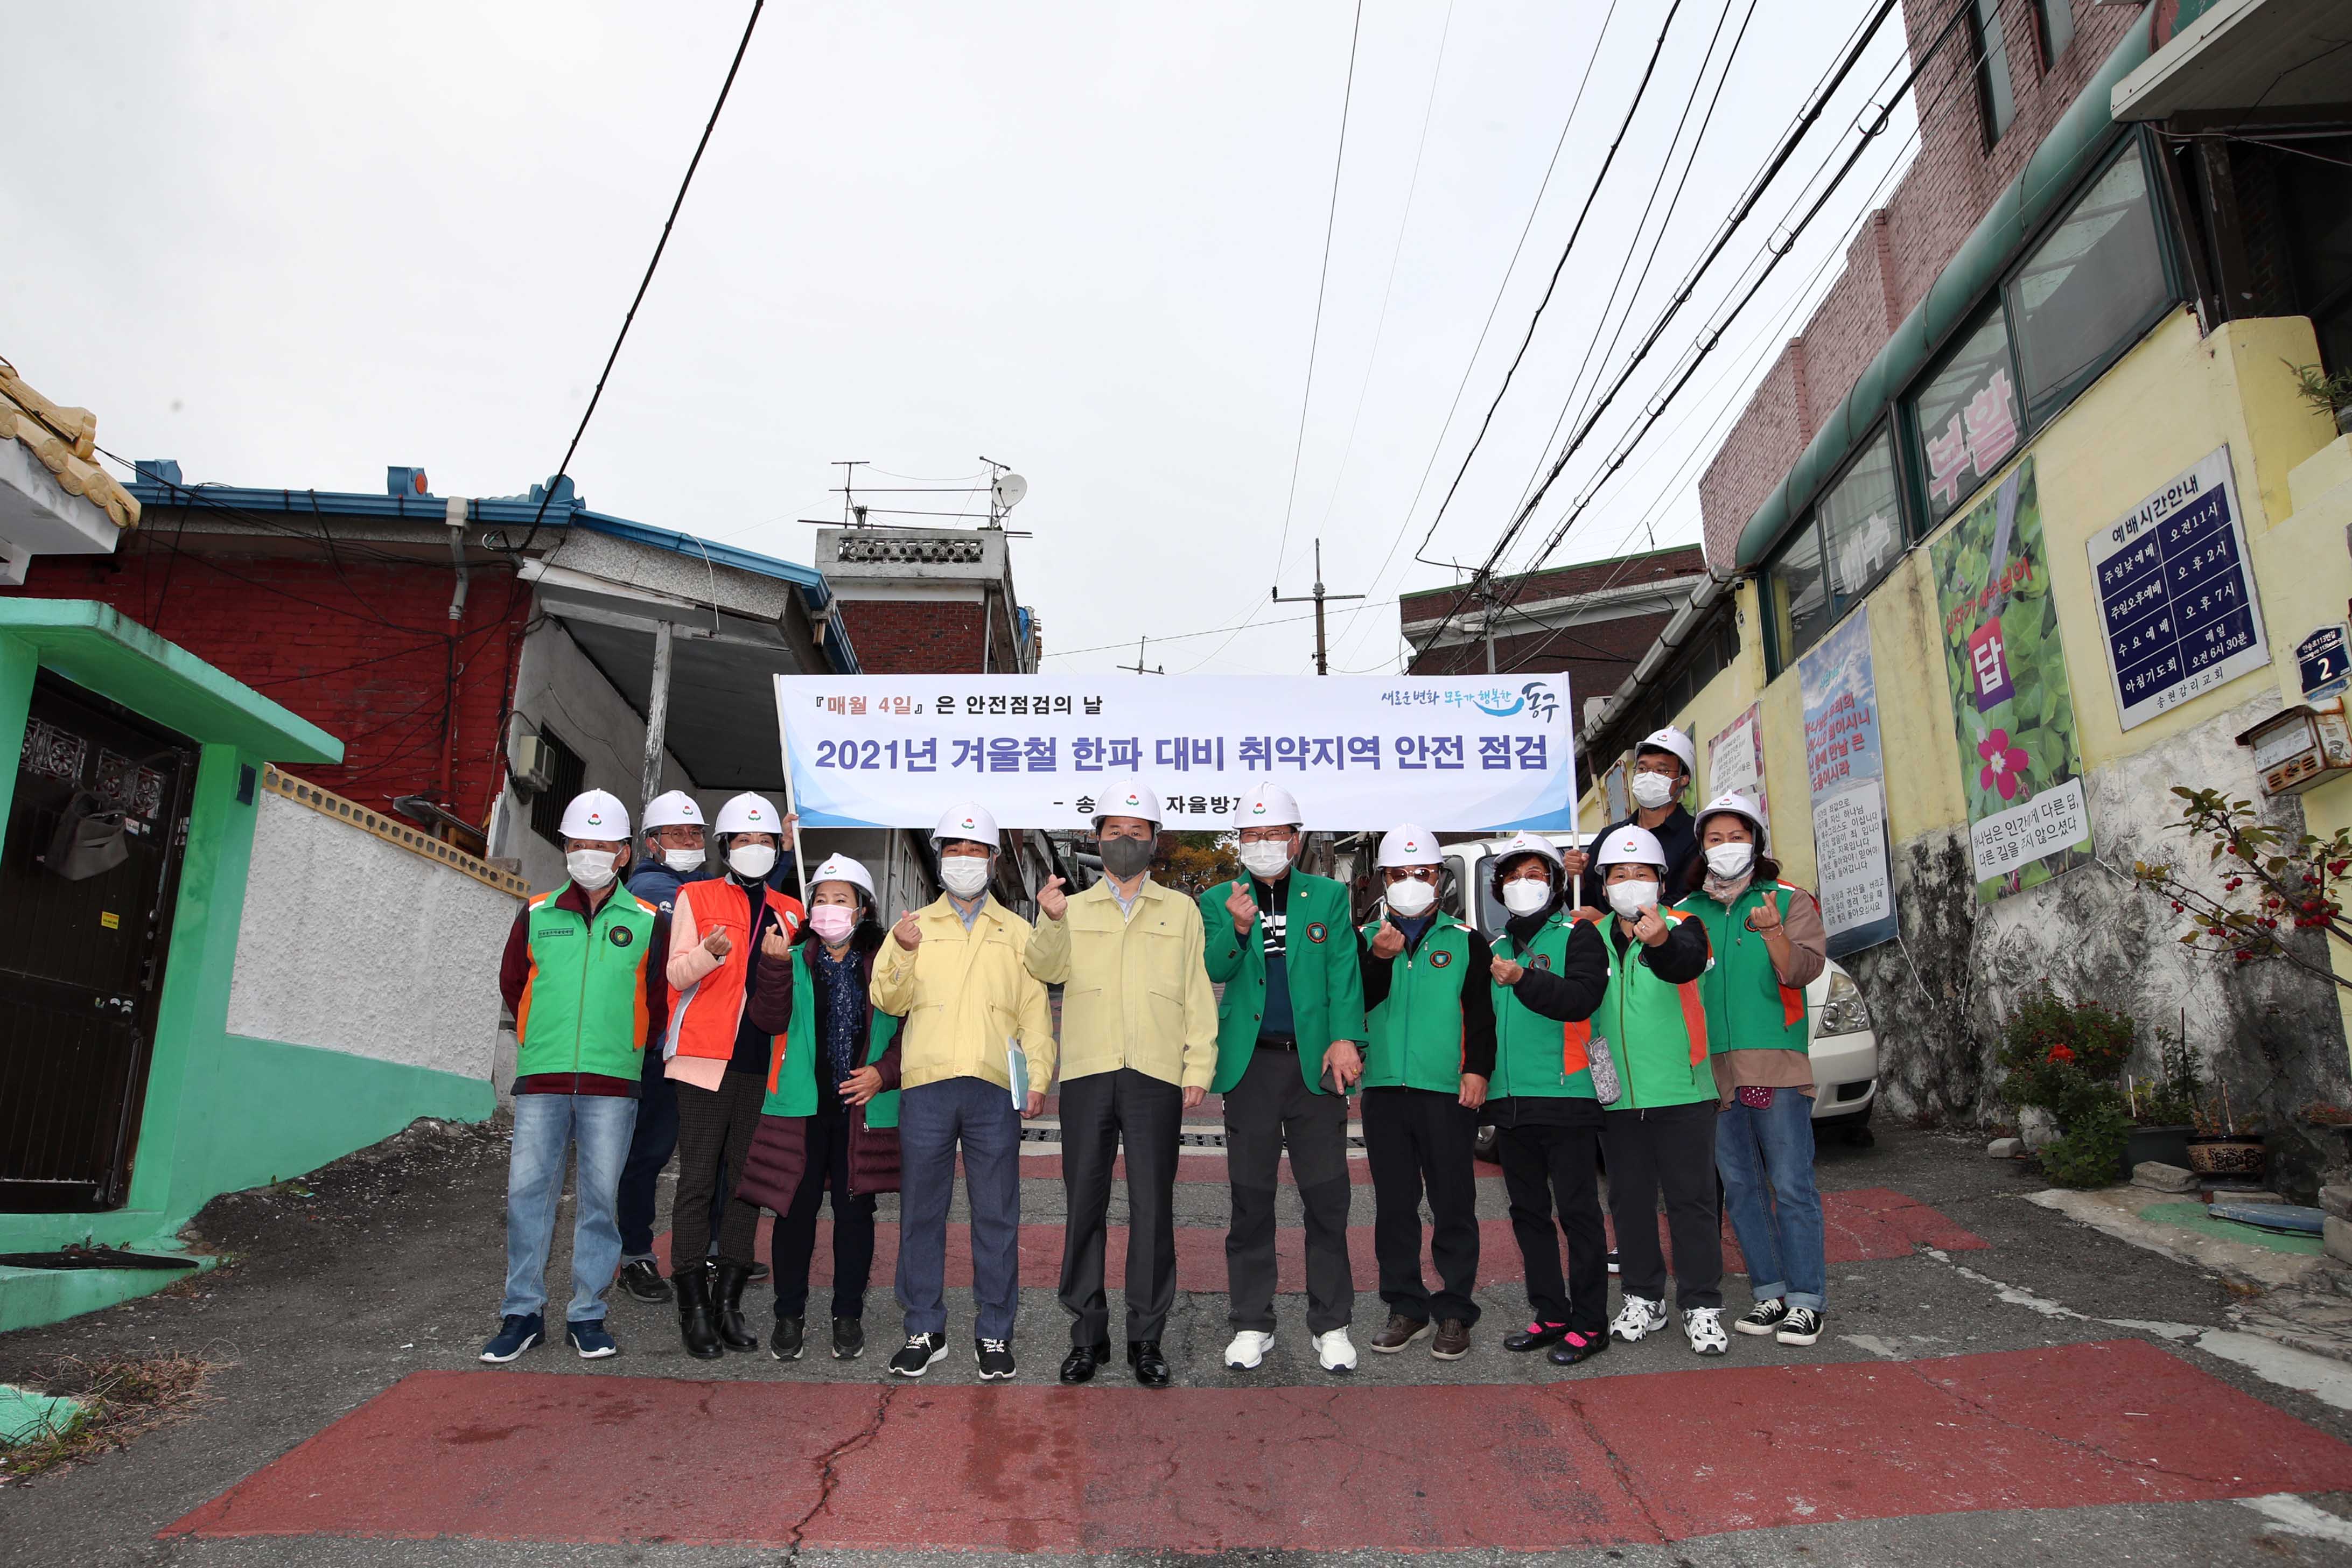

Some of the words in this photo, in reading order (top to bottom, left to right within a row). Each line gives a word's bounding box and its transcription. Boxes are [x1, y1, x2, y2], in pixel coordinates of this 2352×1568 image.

[1926, 367, 2018, 507] 부활
[2112, 474, 2199, 543] 예배시간안내
[2104, 542, 2154, 584] 주일낮예배
[1946, 597, 1977, 636] 십자가
[2111, 579, 2162, 620] 주일오후예배
[2192, 650, 2209, 668] 오전
[2210, 643, 2224, 658] 6시
[2226, 632, 2248, 650] 30분
[2205, 624, 2225, 642] 매일
[1973, 636, 2002, 695] 답
[2125, 656, 2177, 693] 아침기도회
[2318, 657, 2332, 681] 2
[1444, 690, 1474, 708] 모두가
[1478, 689, 1512, 708] 행복한
[1521, 681, 1559, 723] 동구
[1829, 692, 1854, 717] 우리의
[2156, 666, 2224, 709] 송현감리교회
[936, 696, 956, 715] 은
[967, 696, 1071, 715] 안전점검의
[1083, 696, 1103, 715] 날
[1828, 706, 1870, 741] 힘이시니
[815, 737, 937, 772] 2021년
[951, 737, 1056, 772] 겨울철
[1072, 737, 1143, 772] 한파
[1156, 737, 1224, 771] 대비
[1239, 736, 1381, 771] 취약지역
[1395, 735, 1464, 769] 안전
[1478, 734, 1547, 769] 점검
[1829, 738, 1848, 761] 만날
[1852, 733, 1865, 751] 큰
[1166, 795, 1241, 814] 자율방
[1844, 805, 1864, 818] 하나님
[1852, 811, 1878, 827] 이십니다
[2041, 798, 2065, 818] 다른
[2067, 793, 2079, 810] 답,
[1838, 837, 1870, 854] 지옥입니다
[1851, 829, 1857, 838] 죄
[1861, 822, 1879, 836] 입니다
[1979, 849, 1996, 867] 다른
[1997, 842, 2019, 862] 길을
[2035, 815, 2077, 845] 않으셨다
[1846, 897, 1859, 908] 열려
